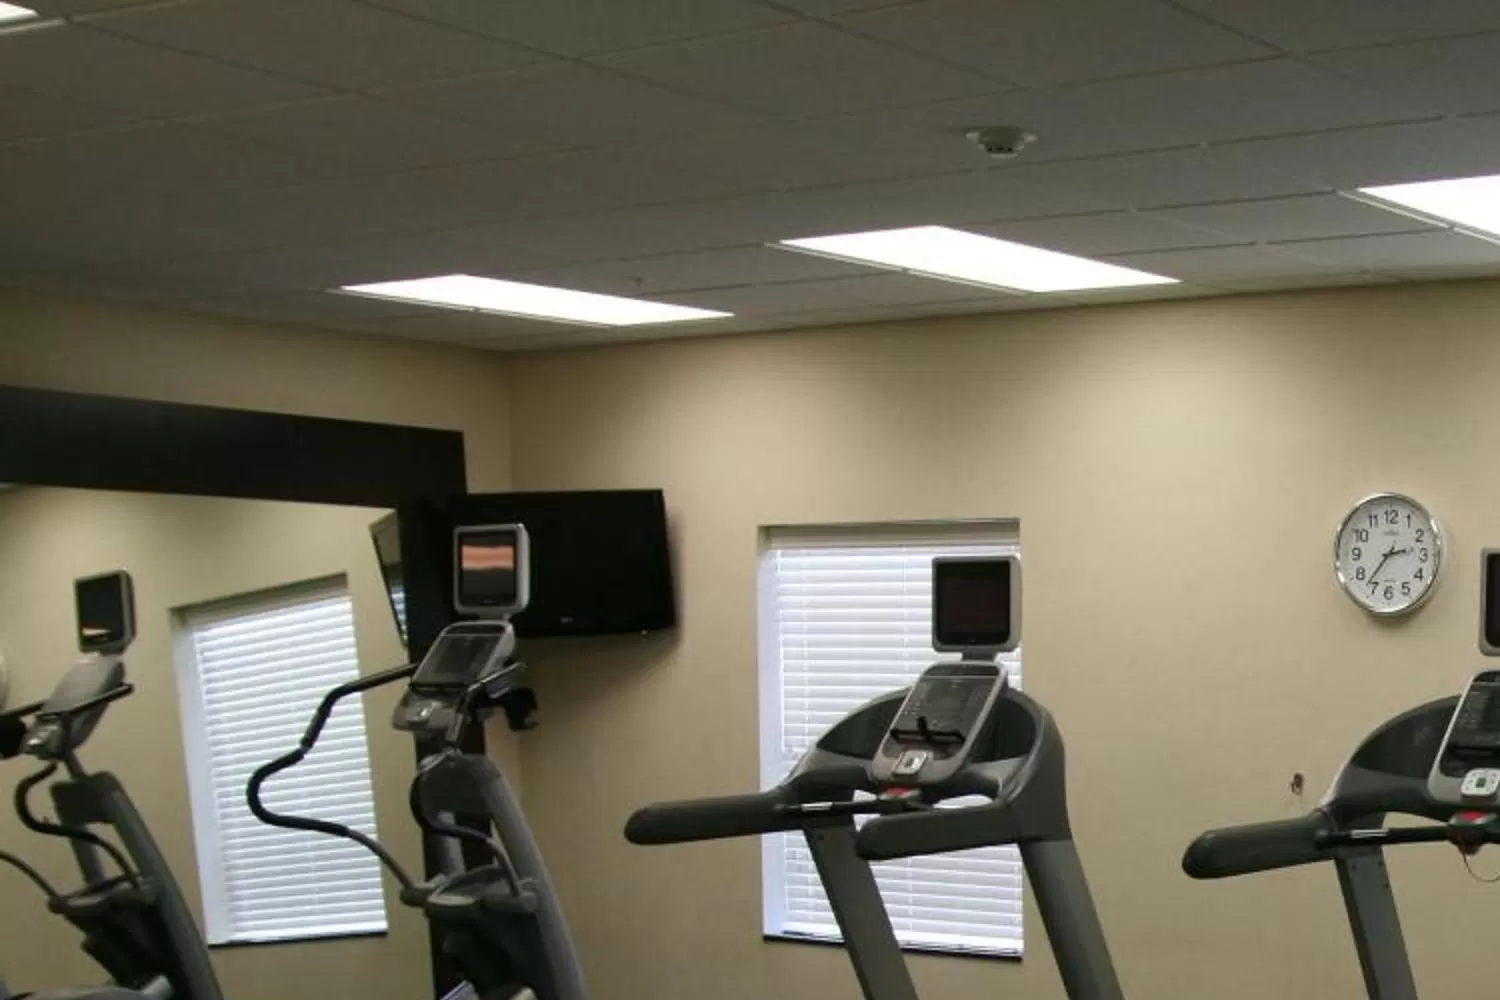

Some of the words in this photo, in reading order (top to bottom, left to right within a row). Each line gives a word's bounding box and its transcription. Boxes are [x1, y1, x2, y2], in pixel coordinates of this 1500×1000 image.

[1368, 514, 1379, 528] 11
[1384, 509, 1399, 524] 12
[1406, 514, 1411, 528] 1
[1352, 528, 1369, 542] 10
[1415, 528, 1424, 543] 2
[1351, 547, 1361, 561] 9
[1420, 547, 1429, 562] 3
[1356, 566, 1366, 580] 8
[1414, 568, 1424, 581] 4
[1370, 581, 1379, 595] 7
[1383, 586, 1394, 600] 6
[1401, 582, 1411, 595] 5
